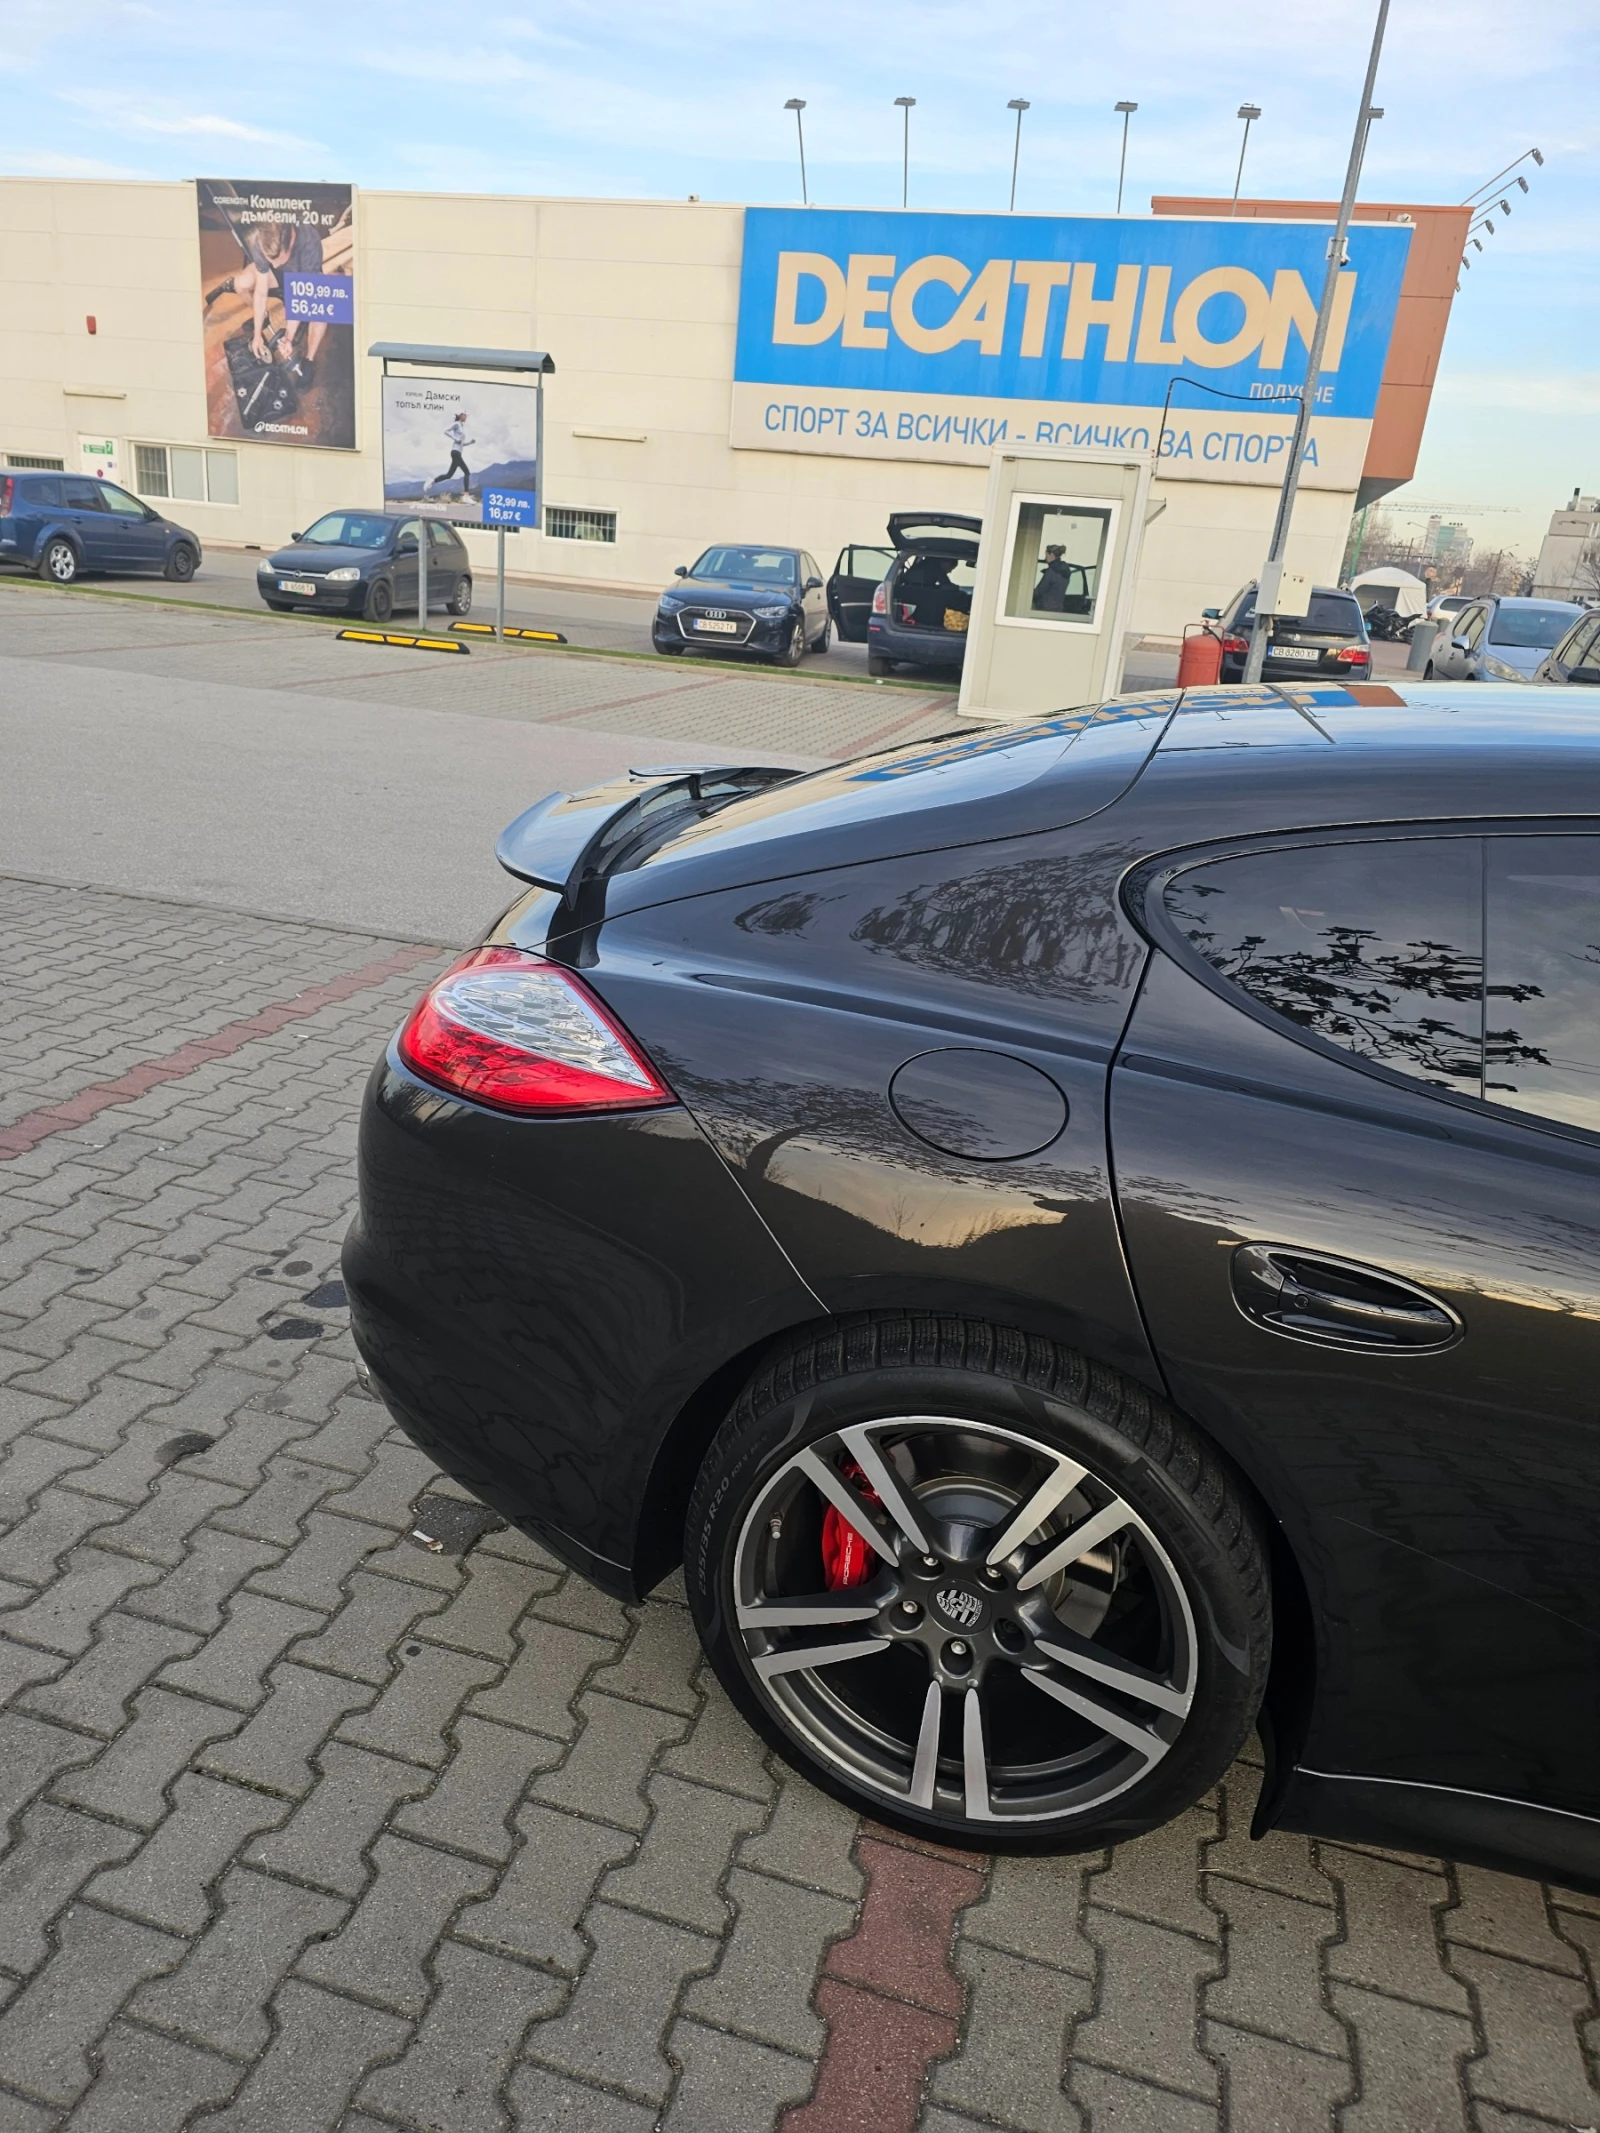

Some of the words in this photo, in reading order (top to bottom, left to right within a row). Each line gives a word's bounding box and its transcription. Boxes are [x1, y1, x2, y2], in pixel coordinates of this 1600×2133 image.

[250, 194, 312, 211] Комплект
[240, 209, 299, 226] дъмбели,
[302, 210, 319, 225] 20
[321, 214, 335, 226] кг
[290, 280, 331, 300] 109,99
[332, 288, 349, 300] лв.
[291, 298, 325, 317] 56,24
[326, 303, 335, 316] €
[772, 250, 1358, 373] DECATHLON
[425, 390, 461, 402] Дамски
[395, 400, 422, 410] топъл
[424, 403, 445, 412] клин
[265, 423, 309, 436] DECATHLON
[764, 403, 850, 436] СПОРТ
[855, 410, 889, 439] ЗА
[896, 413, 1008, 446] ВСИЧКИ
[1159, 430, 1194, 460] ЗА
[488, 493, 516, 508] 32,99
[488, 507, 514, 521] 16,87
[708, 1476, 730, 1520] R20
[842, 1531, 854, 1586] PORSCHE
